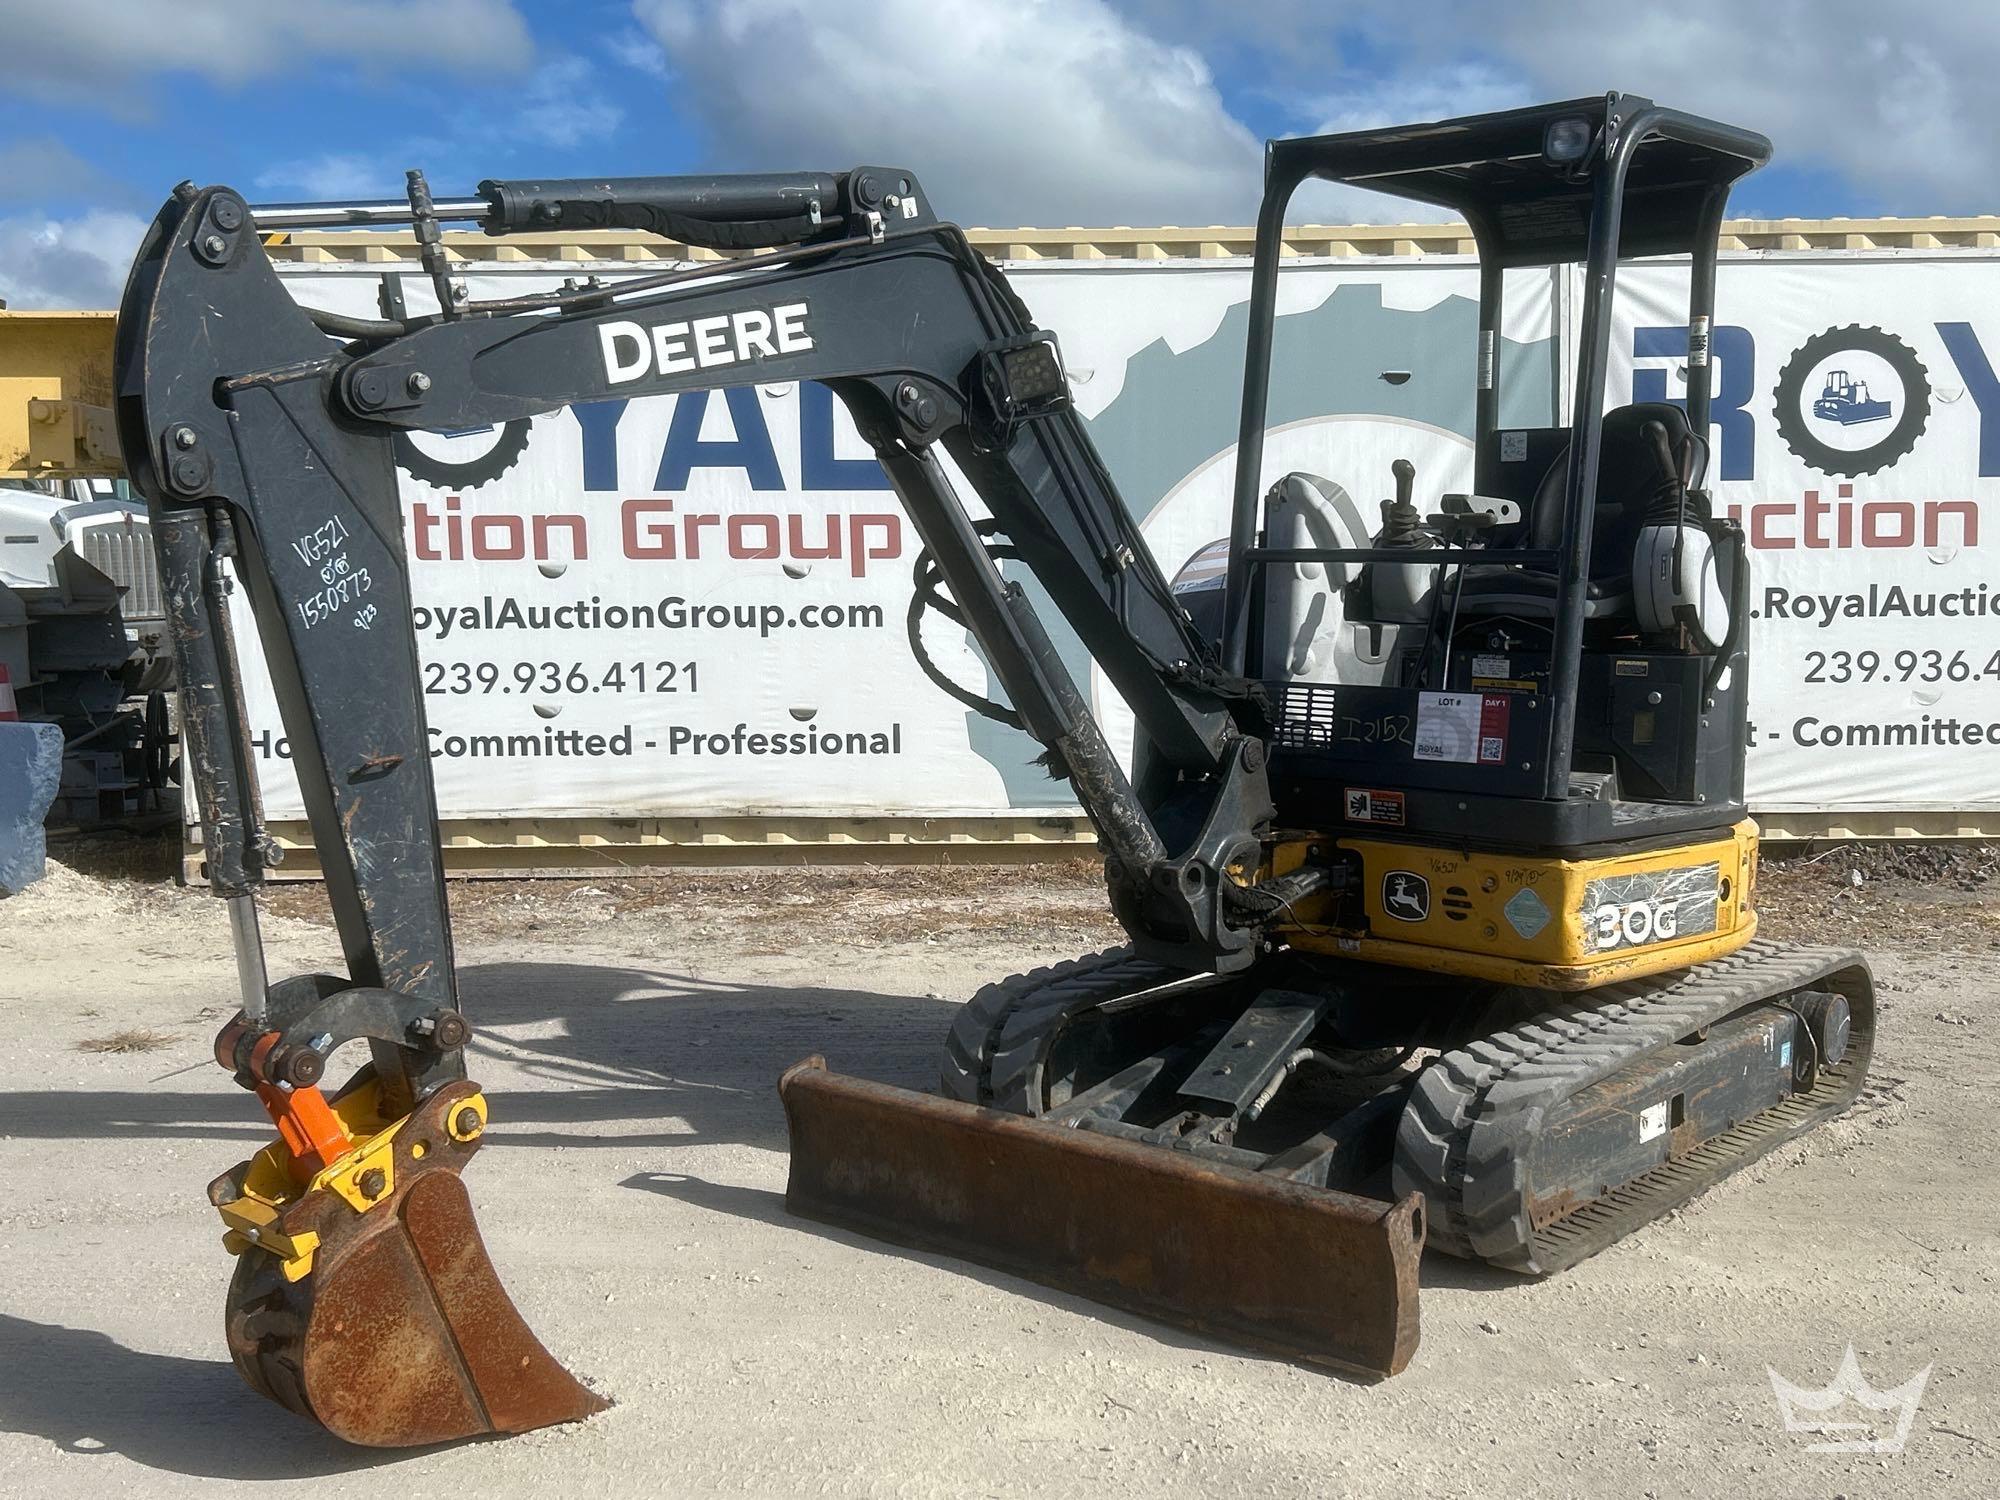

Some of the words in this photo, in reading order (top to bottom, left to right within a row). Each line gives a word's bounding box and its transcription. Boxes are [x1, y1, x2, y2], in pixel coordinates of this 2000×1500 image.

[598, 303, 814, 385] DEERE
[402, 497, 588, 560] tion
[621, 498, 902, 578] Group
[1728, 484, 1978, 549] ction
[298, 568, 371, 629] 1550873
[413, 596, 884, 639] oyalAuctionGroup.com
[425, 661, 699, 695] 239.936.4121
[1438, 698, 1455, 706] LOT
[1485, 699, 1502, 707] DAY
[669, 723, 901, 756] Professional
[1597, 901, 1679, 948] 30G
